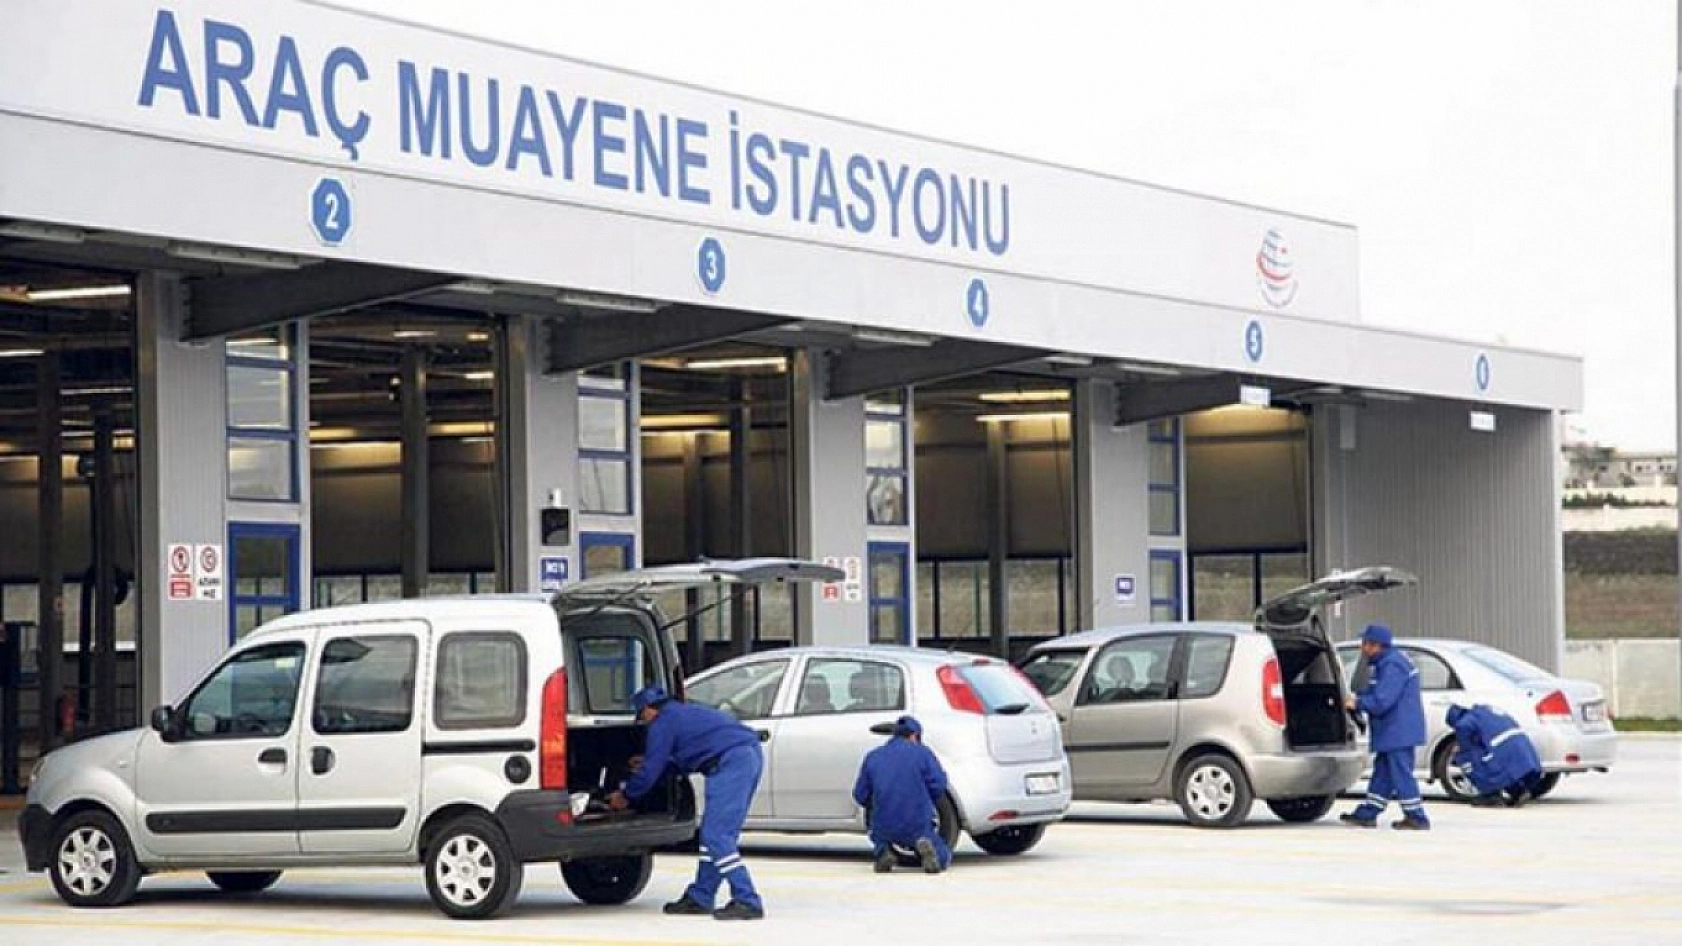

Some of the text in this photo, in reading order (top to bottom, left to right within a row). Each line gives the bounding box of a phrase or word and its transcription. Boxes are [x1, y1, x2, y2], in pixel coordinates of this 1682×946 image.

[138, 9, 1010, 256] ARAÇ MUAYENE İSTASYONU
[325, 193, 339, 229] 2
[705, 251, 717, 281] 3
[972, 289, 984, 316] 4
